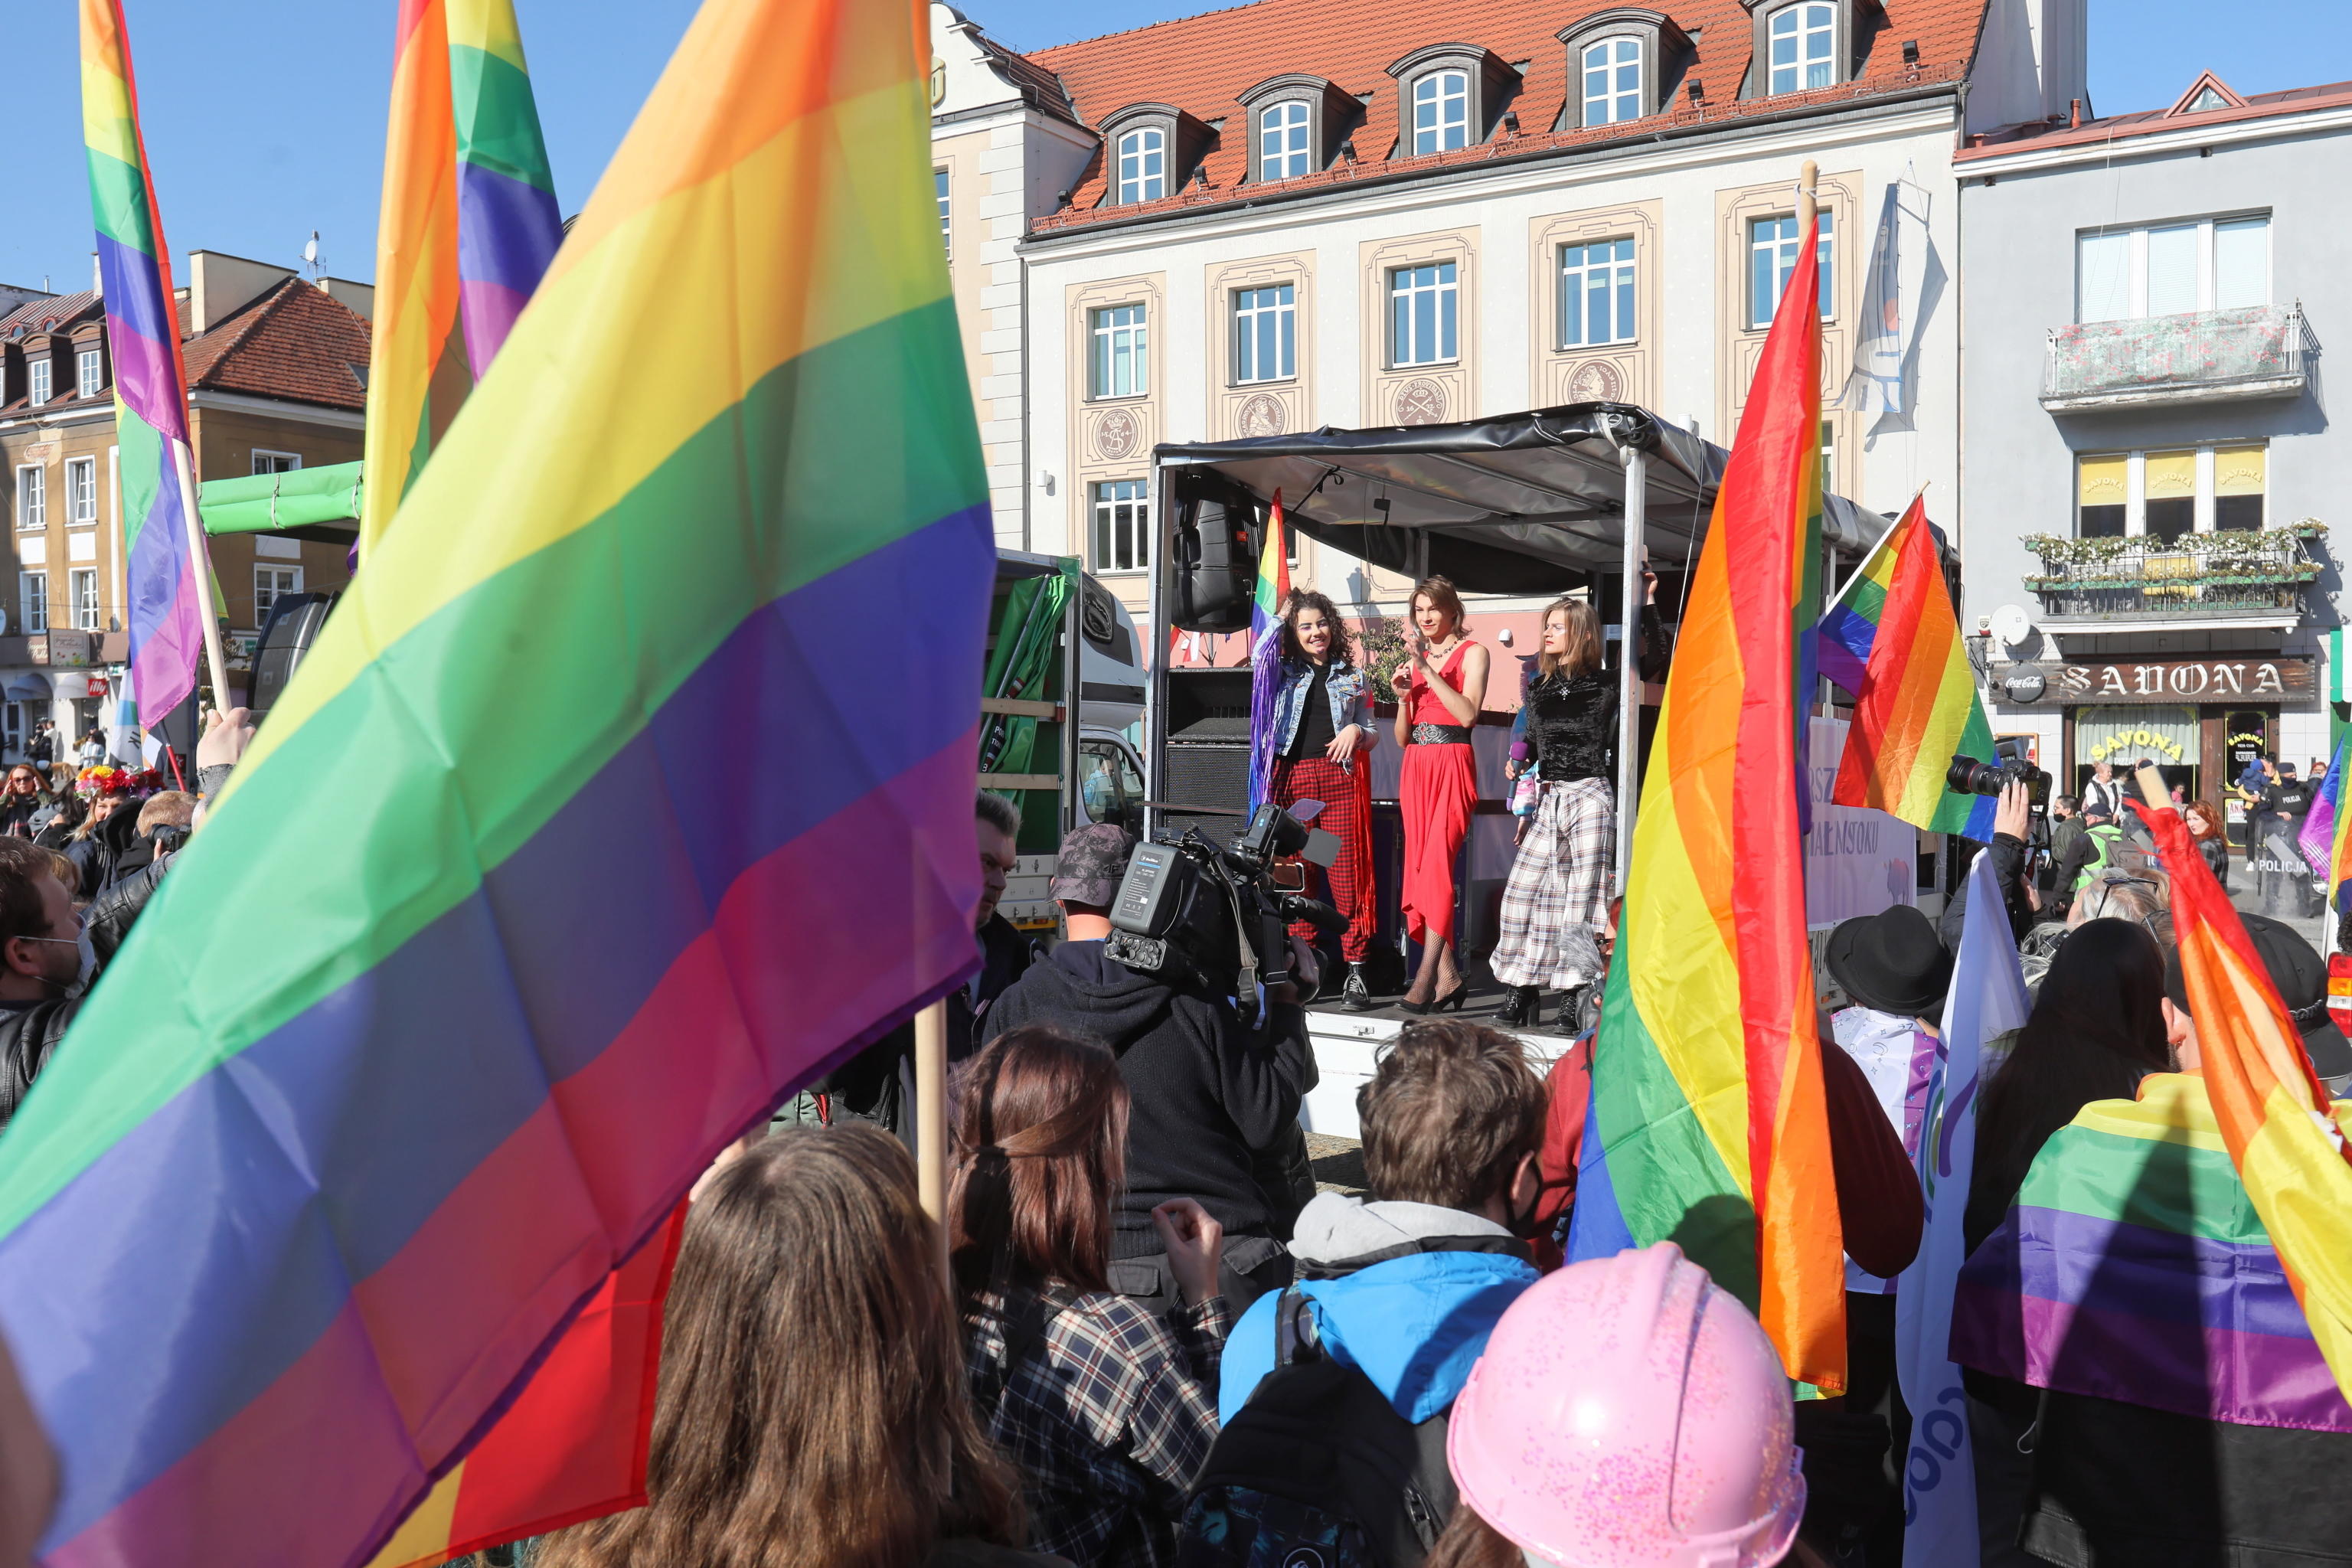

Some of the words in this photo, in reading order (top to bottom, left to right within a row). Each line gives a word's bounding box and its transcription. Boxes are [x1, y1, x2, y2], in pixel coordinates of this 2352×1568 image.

[2060, 664, 2284, 697] SAVONA
[89, 681, 106, 694] illy
[2091, 730, 2182, 761] SAVONA
[2228, 733, 2263, 746] SAVONA
[2282, 795, 2301, 804] POLICJA
[2259, 860, 2308, 873] POLICJA
